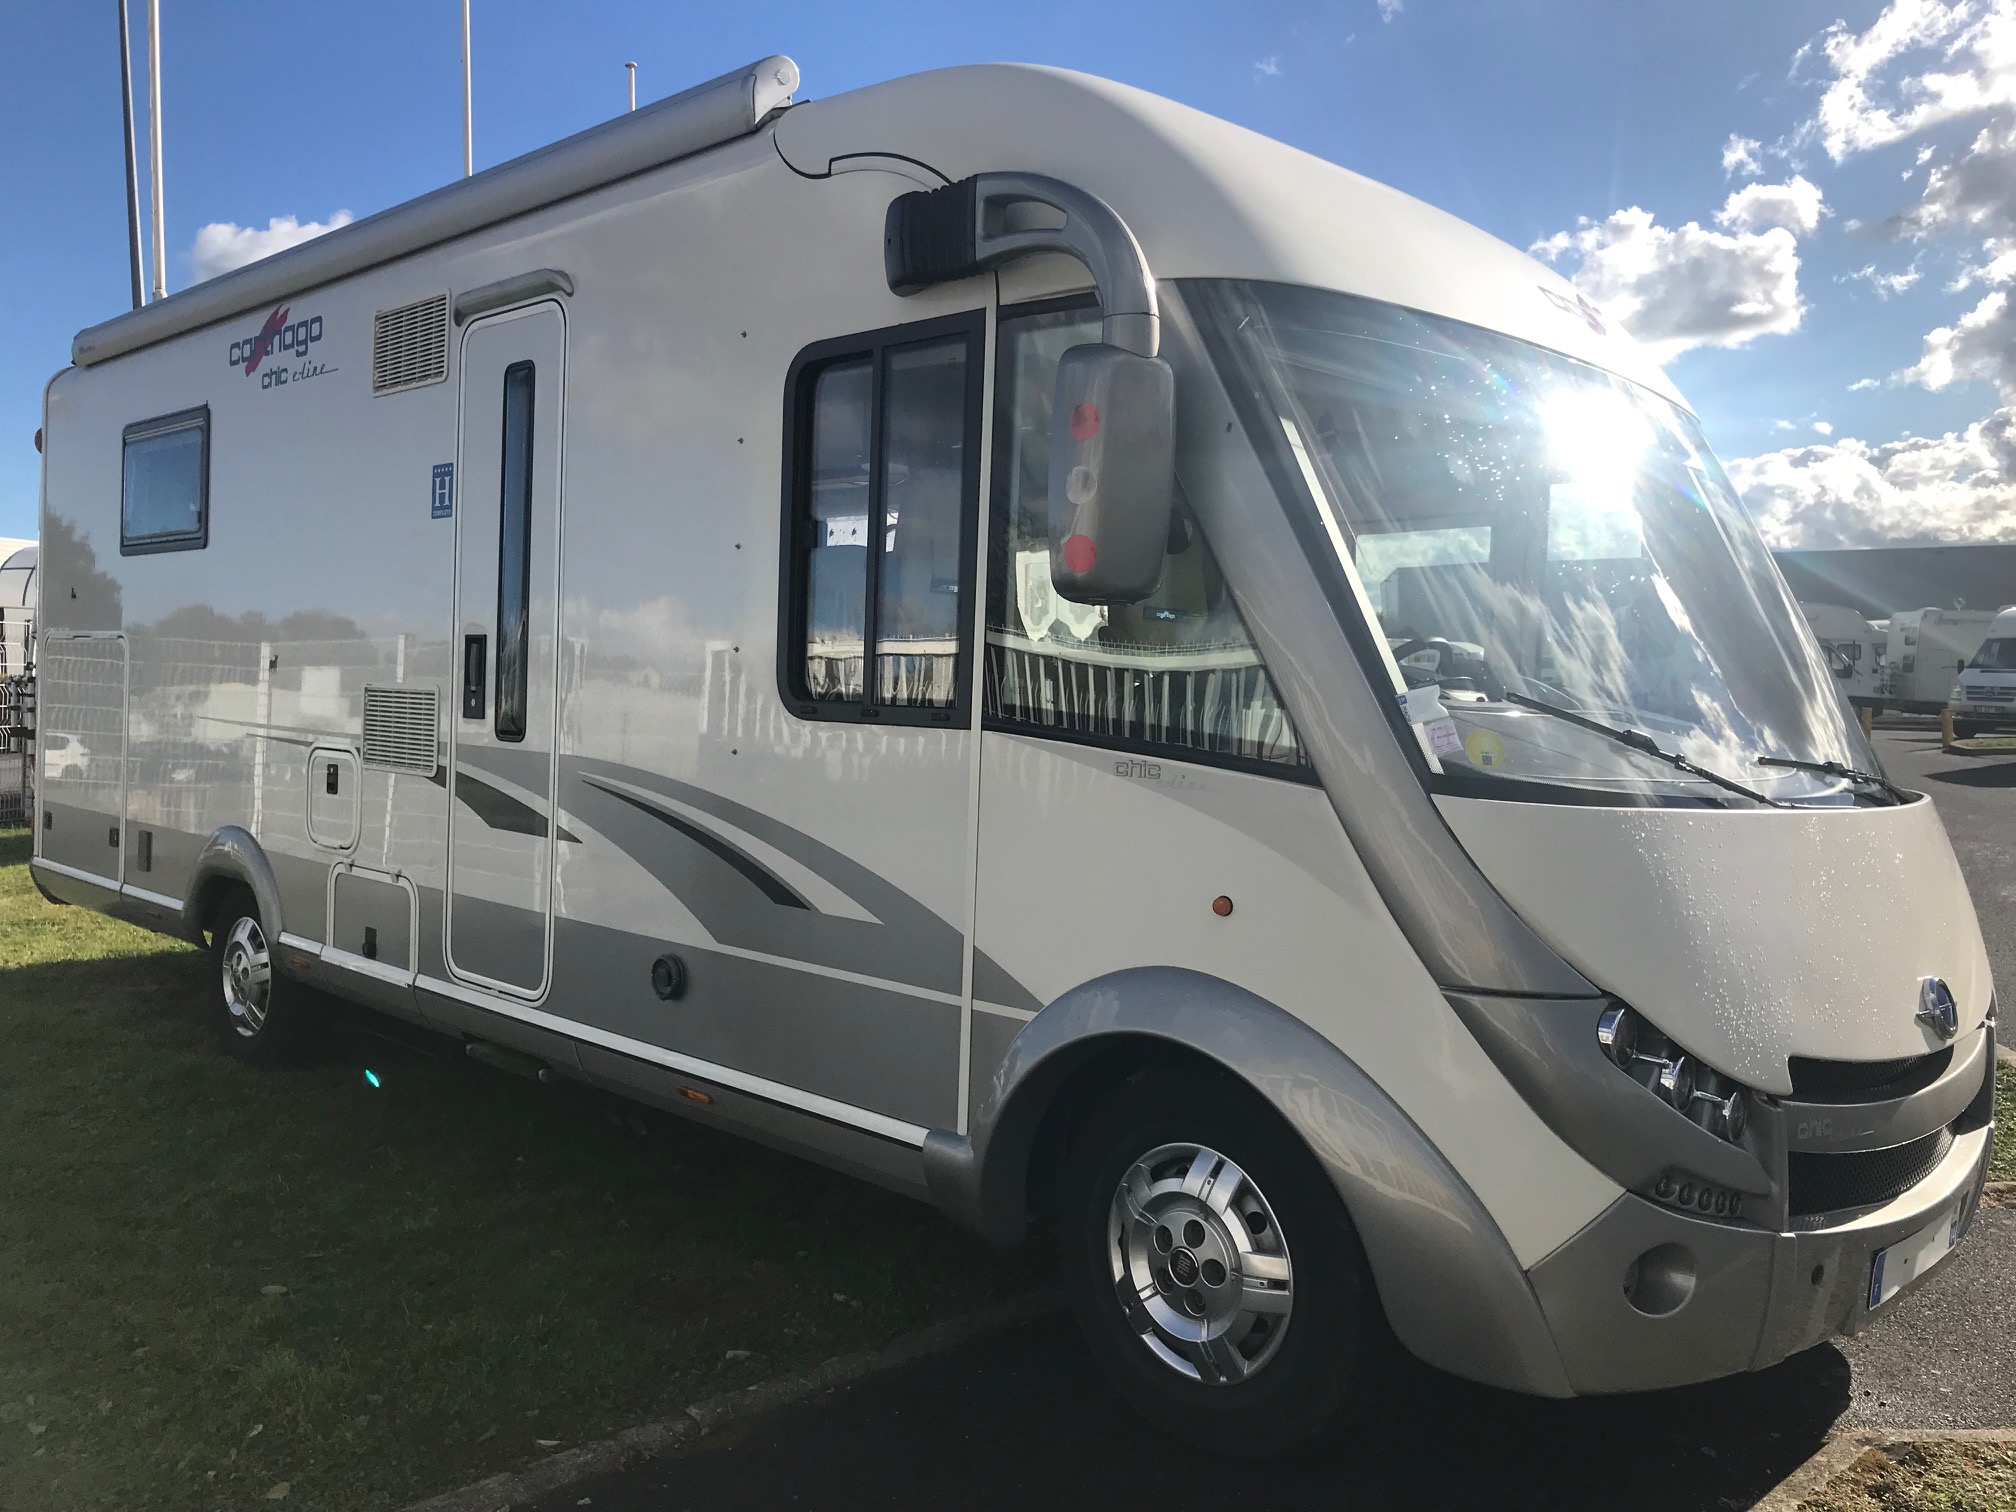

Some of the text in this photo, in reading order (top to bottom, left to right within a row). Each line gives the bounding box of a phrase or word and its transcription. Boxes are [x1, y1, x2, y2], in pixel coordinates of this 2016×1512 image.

[261, 360, 339, 390] chic e-line
[434, 476, 451, 507] H
[1114, 759, 1162, 780] chic
[1176, 1253, 1191, 1277] FIAT
